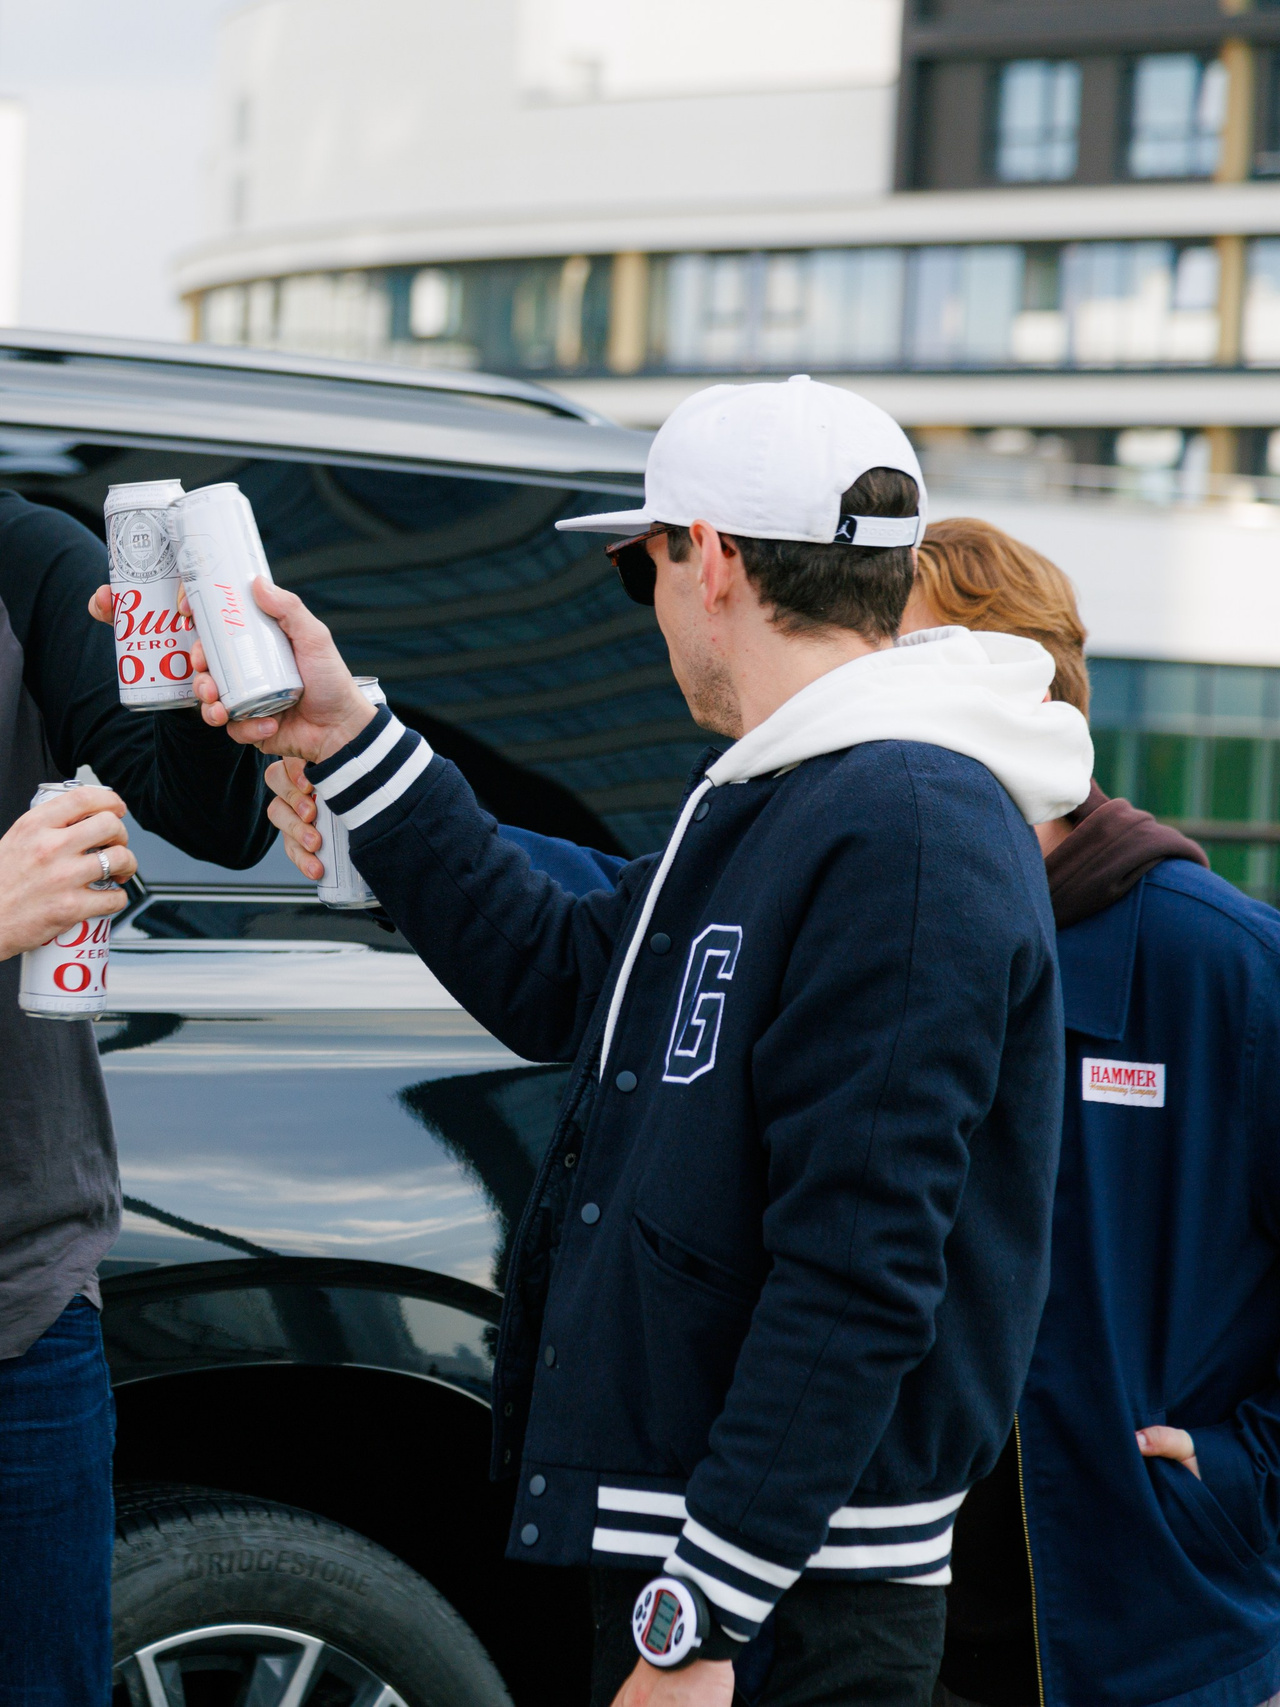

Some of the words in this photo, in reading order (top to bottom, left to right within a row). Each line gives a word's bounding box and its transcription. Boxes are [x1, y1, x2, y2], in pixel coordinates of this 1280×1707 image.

[126, 638, 177, 651] ZERO
[662, 923, 743, 1085] G
[1091, 1065, 1157, 1088] HAMMER
[182, 1548, 374, 1597] BRIDGESTONE
